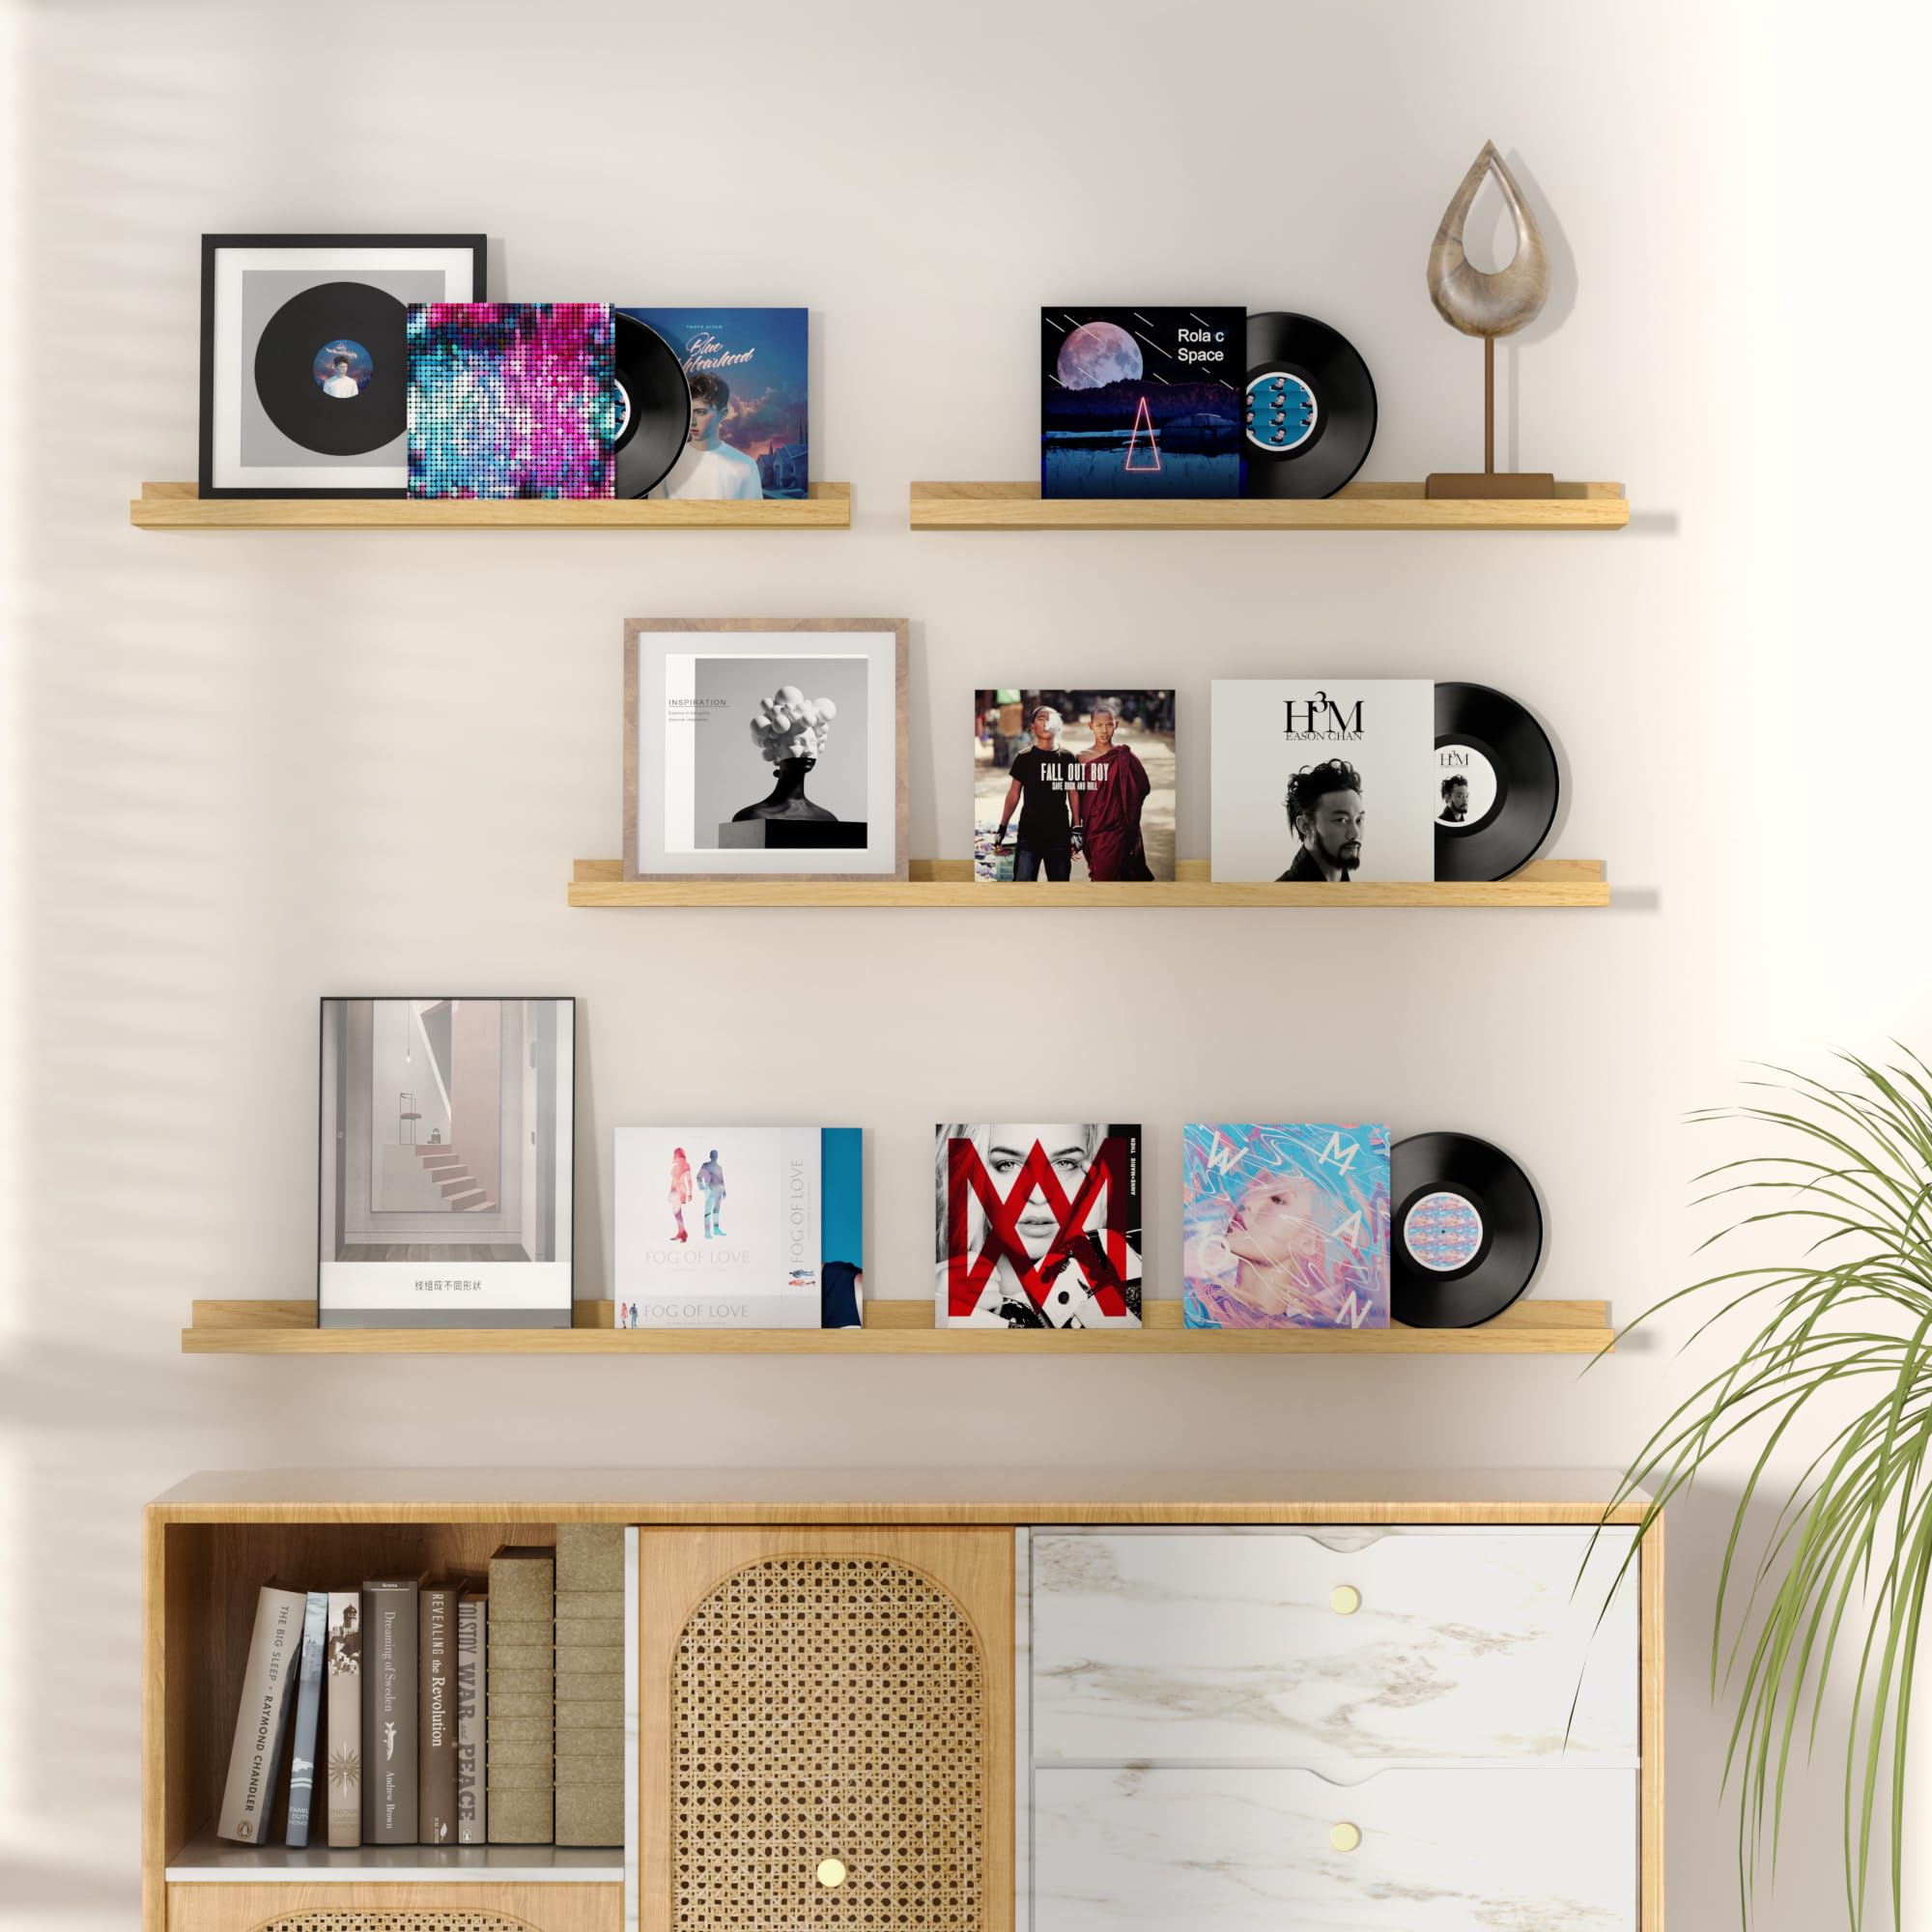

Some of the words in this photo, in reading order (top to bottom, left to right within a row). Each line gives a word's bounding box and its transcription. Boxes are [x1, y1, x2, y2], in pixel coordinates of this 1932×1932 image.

[686, 331, 724, 356] Blue
[1179, 328, 1211, 342] Rola
[1215, 331, 1225, 342] c
[1178, 348, 1224, 364] Space
[1286, 732, 1325, 741] EASON
[1328, 732, 1362, 741] CHAN
[1040, 762, 1064, 781] FALL
[1067, 762, 1087, 781] OUT
[1091, 762, 1109, 781] BOY
[790, 1159, 804, 1198] LOVE
[790, 1206, 804, 1225] OF
[645, 1251, 680, 1264] FOG
[684, 1251, 703, 1264] OF
[710, 1251, 751, 1264] LOVE
[790, 1230, 804, 1263] FOG
[414, 1280, 482, 1291] 线组成不同形状
[644, 1305, 678, 1318] FOG
[683, 1305, 703, 1318] OF
[709, 1305, 751, 1318] LOVE
[277, 1606, 290, 1625] THE
[433, 1594, 444, 1655] REVEALING
[273, 1628, 285, 1648] BIG
[382, 1611, 395, 1661] Dreaming
[459, 1603, 477, 1654] TOLSTOY
[269, 1650, 281, 1682] SLEEP
[385, 1662, 396, 1672] of
[433, 1660, 442, 1673] the
[385, 1673, 396, 1712] Sweden
[459, 1662, 475, 1719] WAR
[256, 1694, 273, 1751] RAYMOND
[433, 1677, 446, 1747] Revolution
[245, 1754, 263, 1812] CHANDLER
[386, 1771, 395, 1801] Andrew
[459, 1744, 475, 1821] PEACE
[386, 1804, 395, 1829] Brown
